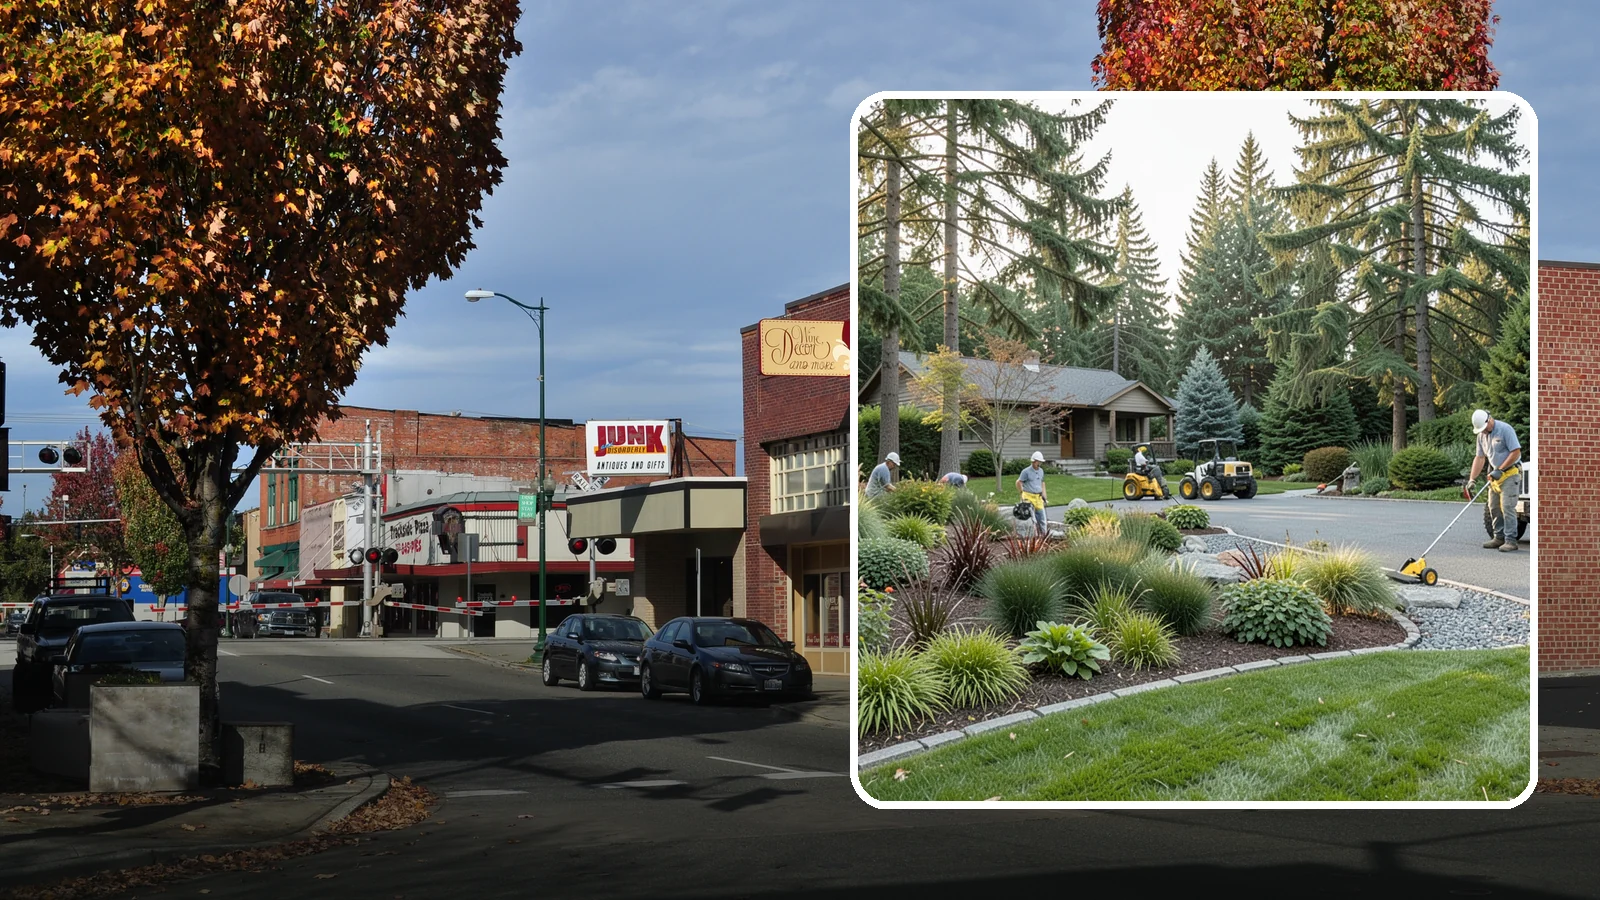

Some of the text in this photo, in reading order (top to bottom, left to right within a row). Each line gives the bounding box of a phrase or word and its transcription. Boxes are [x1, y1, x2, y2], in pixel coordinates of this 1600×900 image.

[765, 328, 831, 365] Decor
[596, 425, 665, 457] JUNK
[607, 446, 646, 454] DISORDERLY
[597, 461, 665, 470] ANTIQUES AND GIFTS
[390, 519, 429, 540] Trackside Pizza
